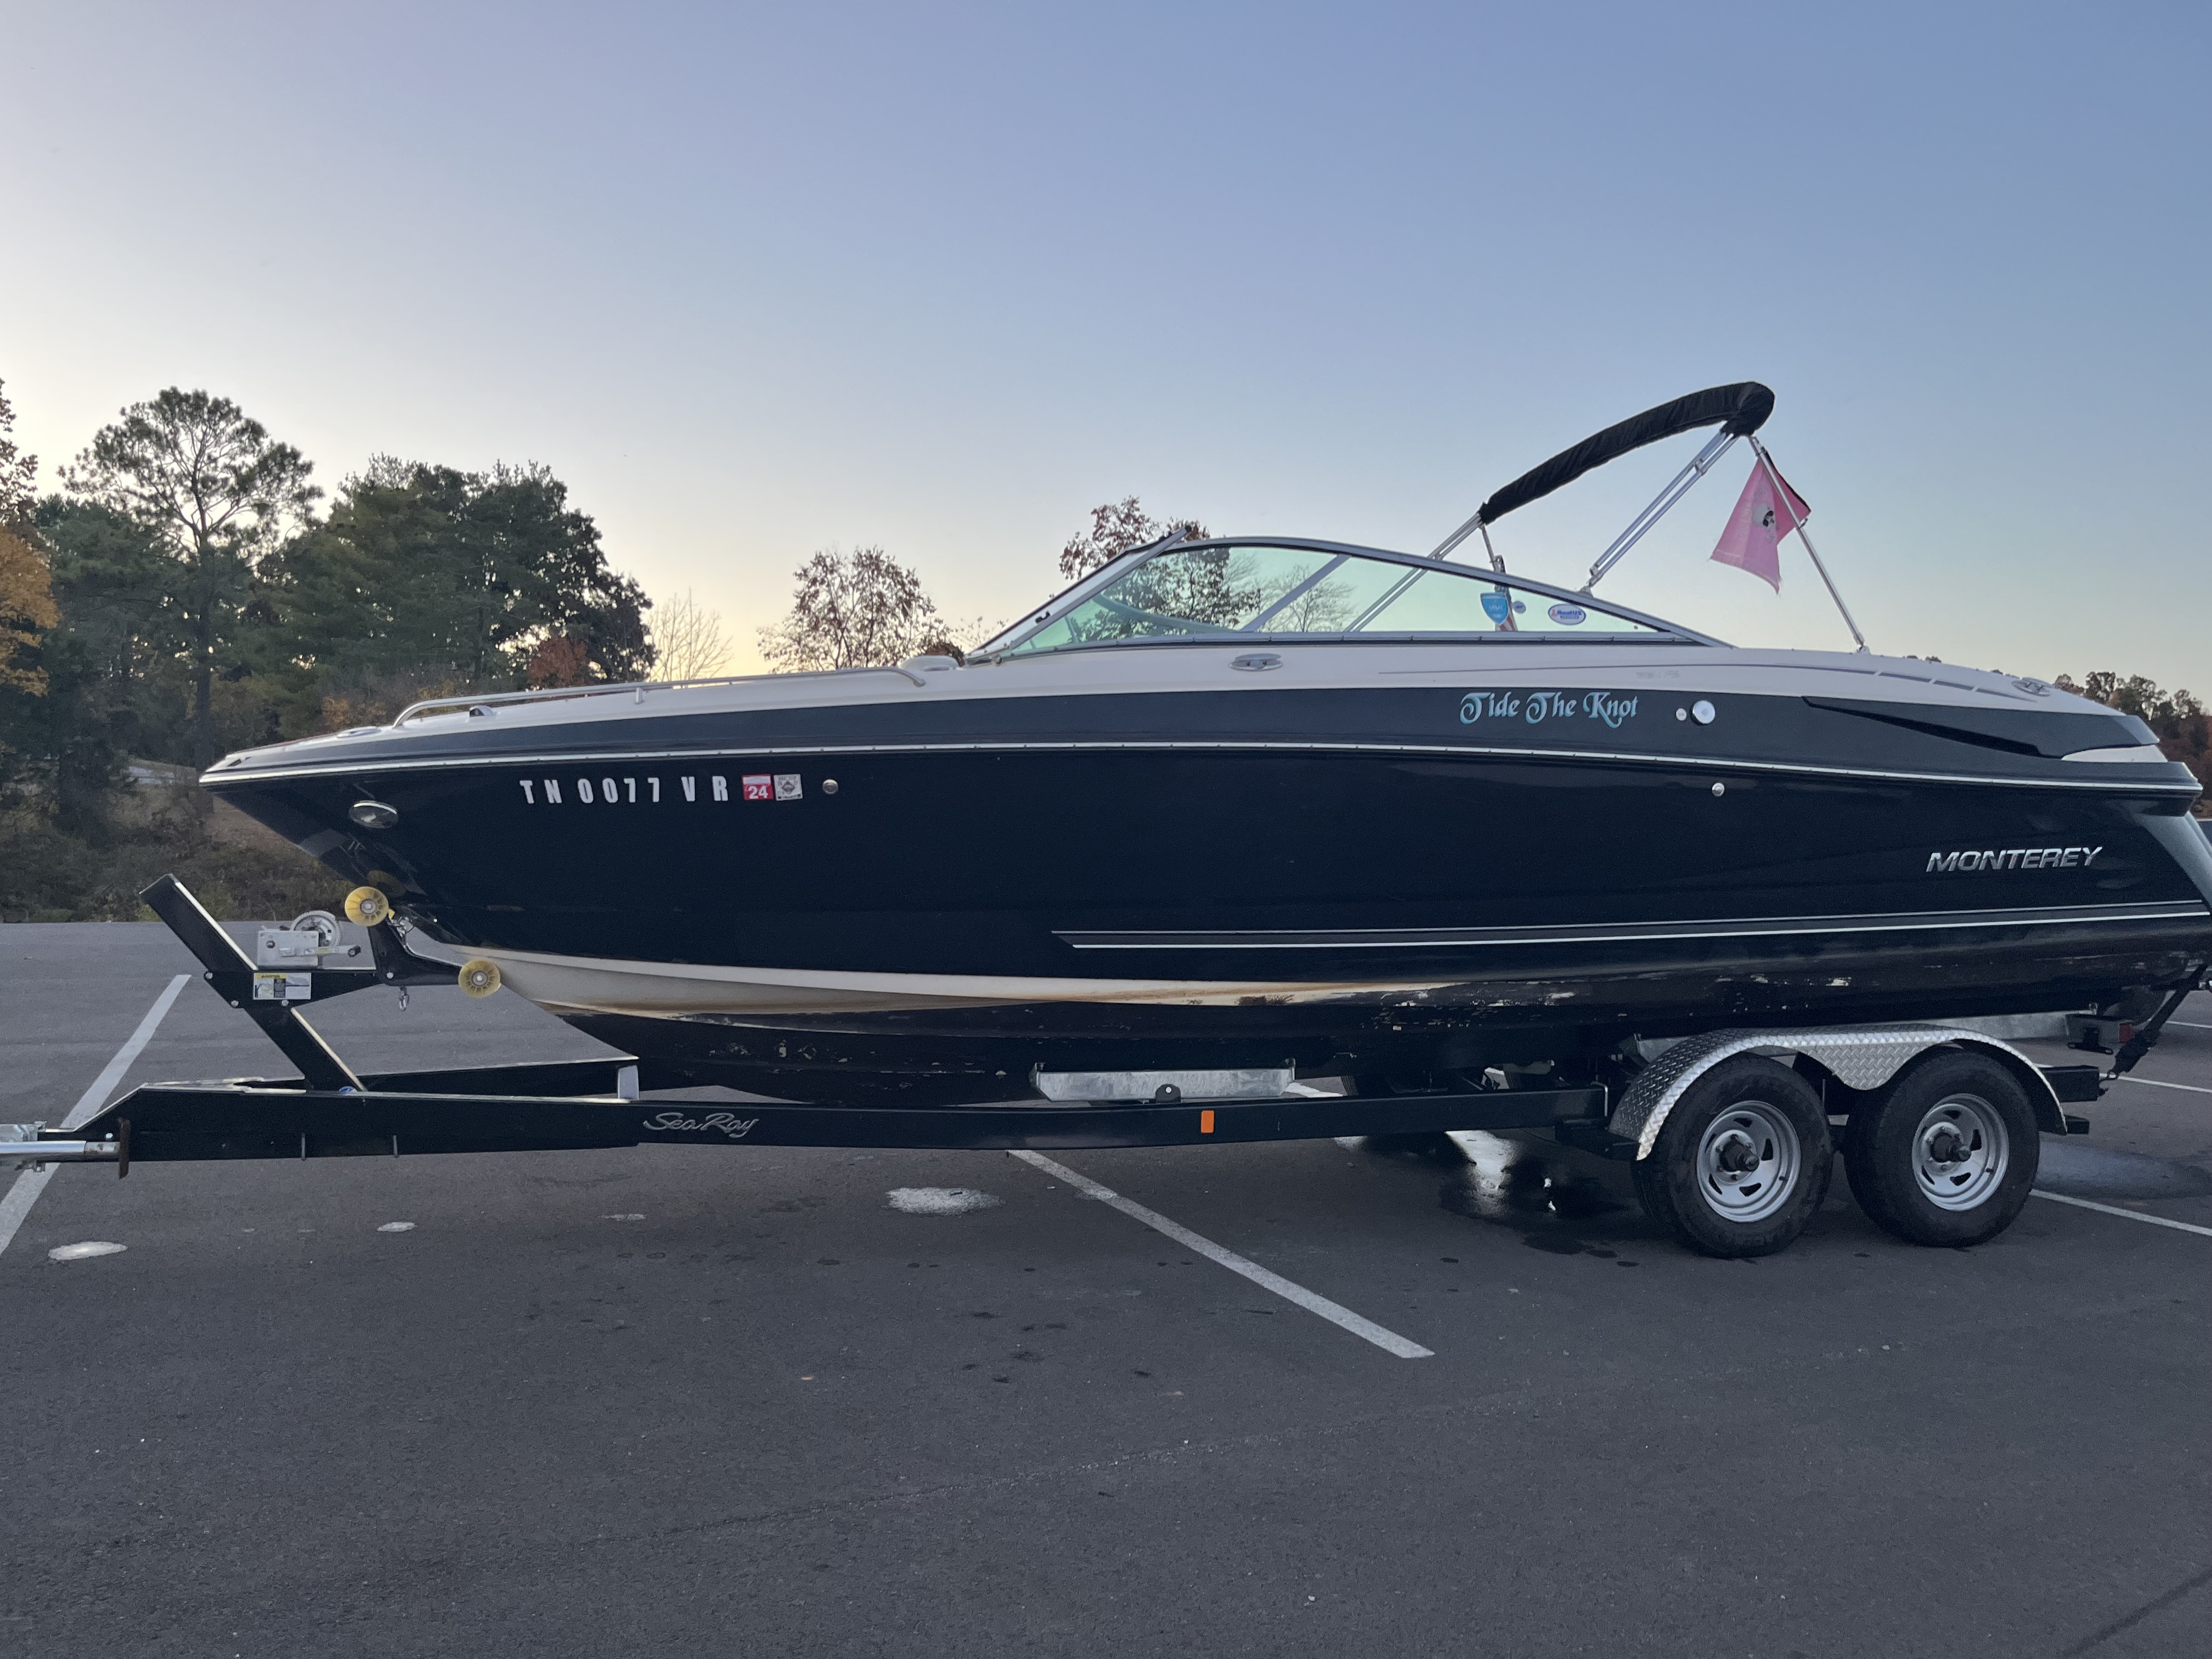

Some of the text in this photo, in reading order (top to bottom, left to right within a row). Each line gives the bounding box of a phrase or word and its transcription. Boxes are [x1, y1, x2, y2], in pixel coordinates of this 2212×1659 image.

[1460, 692, 1638, 729] Tide The Knot
[520, 779, 562, 804] TN
[578, 778, 660, 804] 0077
[749, 786, 768, 799] 24
[1926, 847, 2103, 872] MONTEREY
[643, 1112, 759, 1138] Sea Ray
